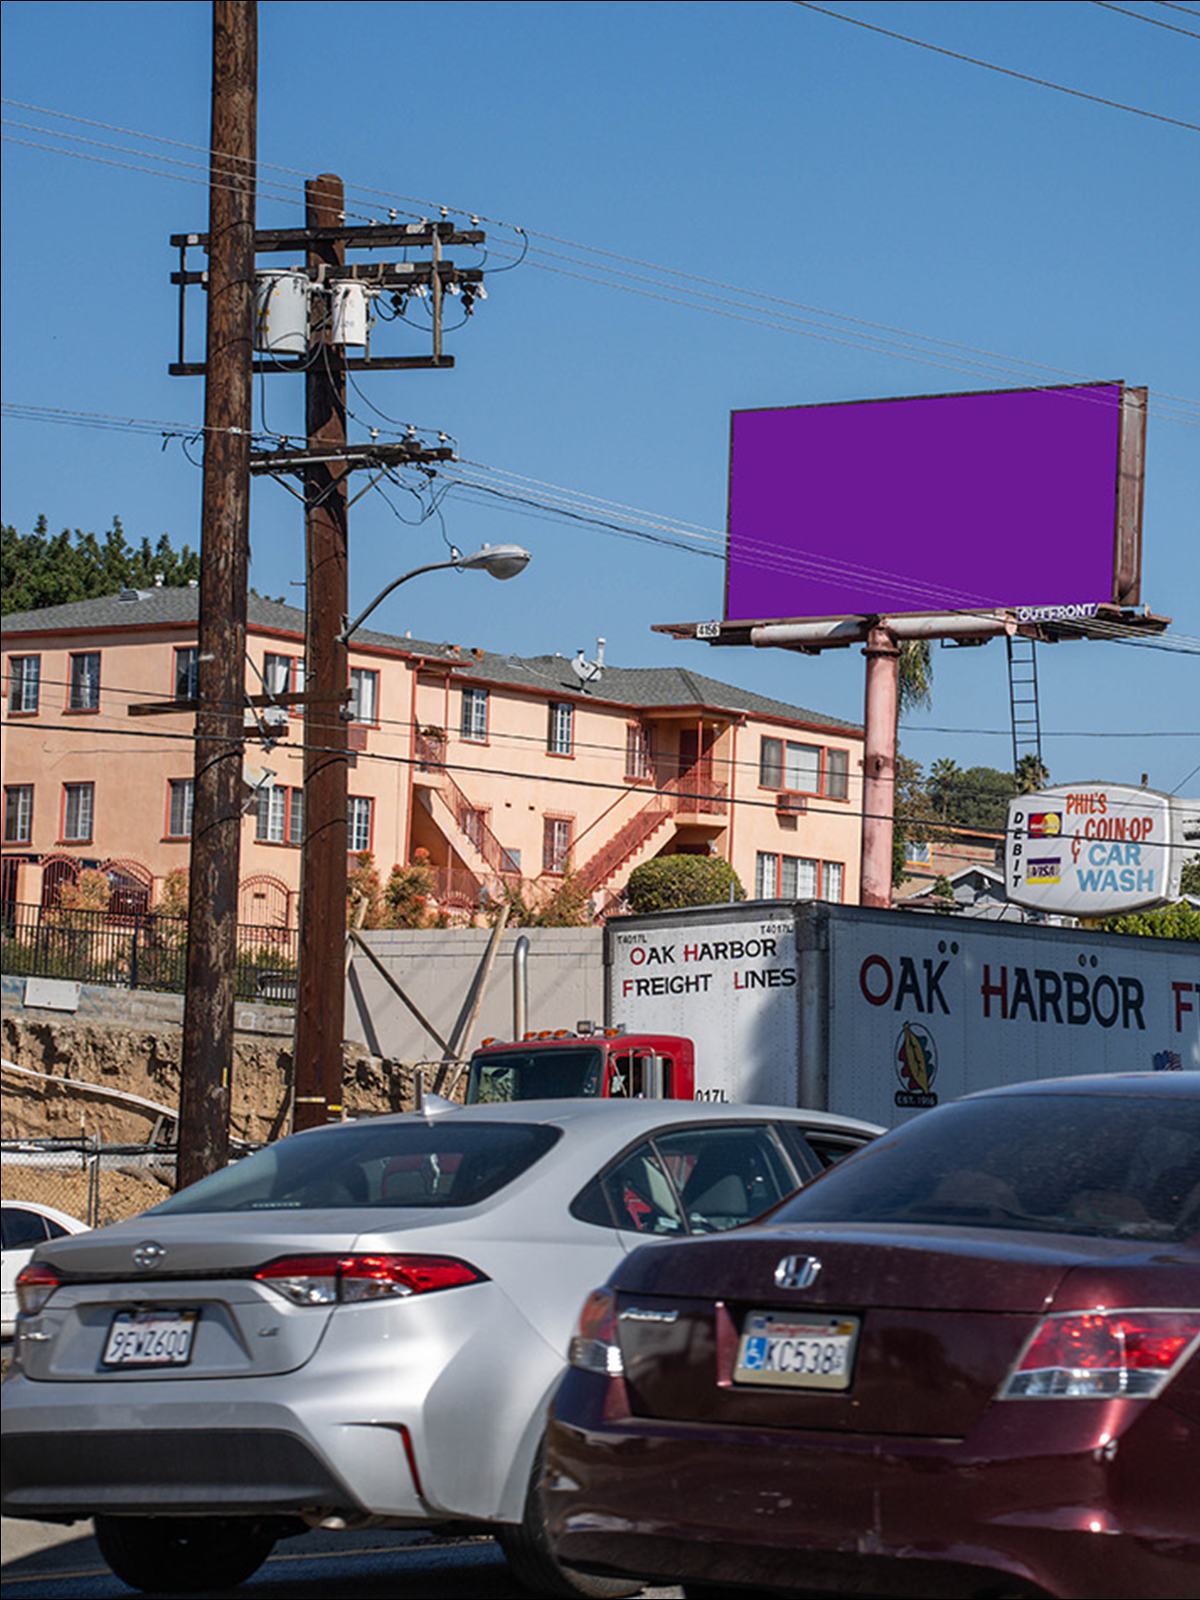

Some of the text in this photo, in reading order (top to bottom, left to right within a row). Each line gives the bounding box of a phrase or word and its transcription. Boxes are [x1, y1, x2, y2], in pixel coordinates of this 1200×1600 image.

[1019, 603, 1096, 621] OUTFRONT
[1066, 793, 1108, 814] PHIL'S
[1085, 817, 1153, 842] COIN-OP
[1012, 812, 1024, 887] DEBIT
[1088, 843, 1142, 866] CAR
[1031, 866, 1055, 877] VISA
[1077, 868, 1154, 892] WASH
[630, 938, 777, 966] OAK HARBOR
[623, 968, 797, 998] FREIGHT LINES
[860, 954, 950, 1015] OAK
[981, 964, 1146, 1030] HARBOR
[695, 1089, 729, 1103] 017L
[109, 1329, 189, 1357] 9EWZ600
[764, 1340, 837, 1374] KC538
